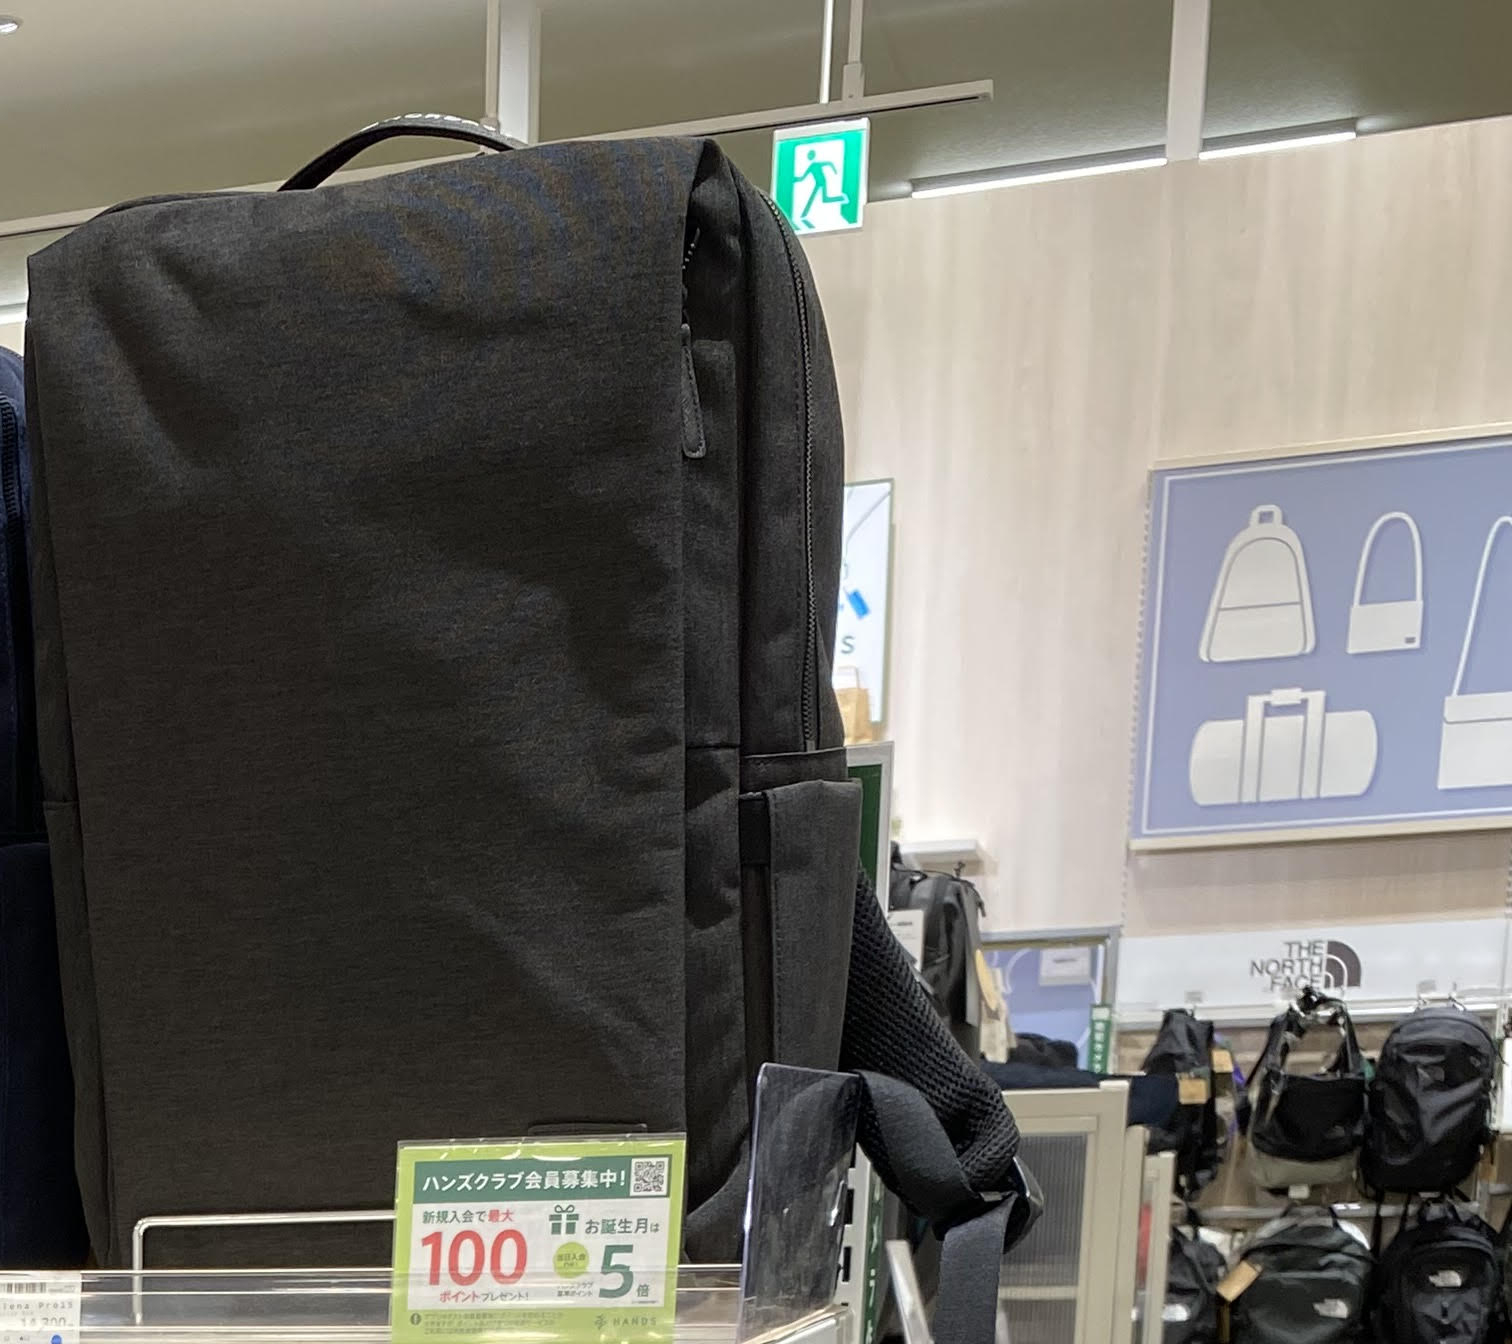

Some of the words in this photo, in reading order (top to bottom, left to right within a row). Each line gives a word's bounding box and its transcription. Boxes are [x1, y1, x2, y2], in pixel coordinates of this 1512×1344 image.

[1283, 940, 1324, 959] THE
[1250, 959, 1323, 976] NORTH
[422, 1209, 514, 1225] 新規入会で最大
[585, 1218, 660, 1235] お誕生月は
[421, 1229, 528, 1286] 100
[613, 1317, 656, 1326] HANDS
